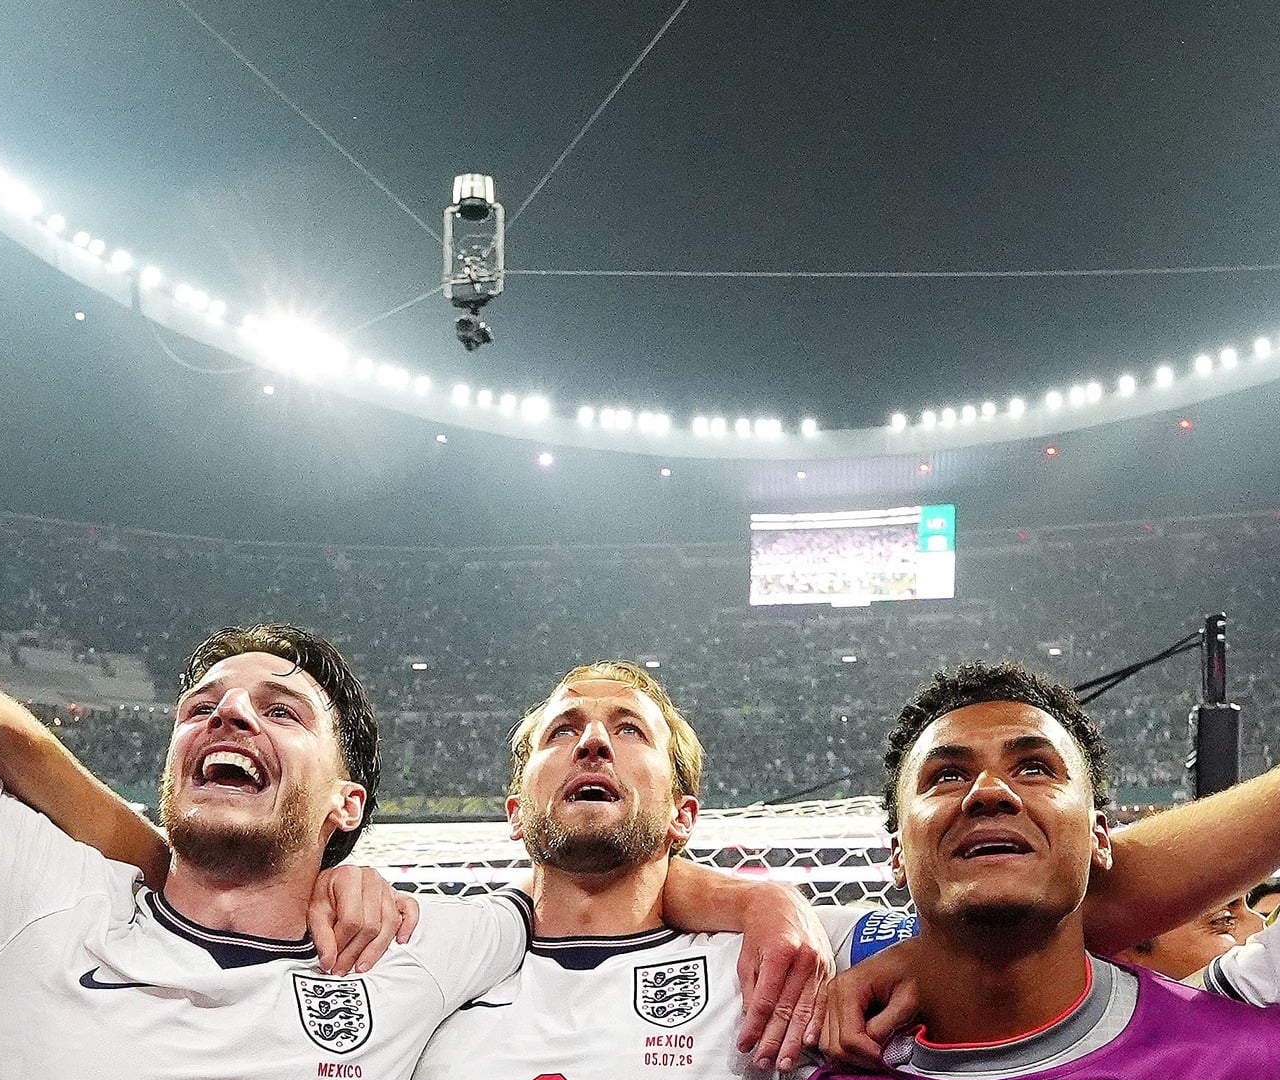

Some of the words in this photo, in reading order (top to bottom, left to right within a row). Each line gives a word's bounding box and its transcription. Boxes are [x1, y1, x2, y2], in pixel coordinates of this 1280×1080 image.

[646, 1034, 694, 1049] MEXICO
[644, 1052, 693, 1067] 05.07.26
[317, 1062, 362, 1078] MEXICO
